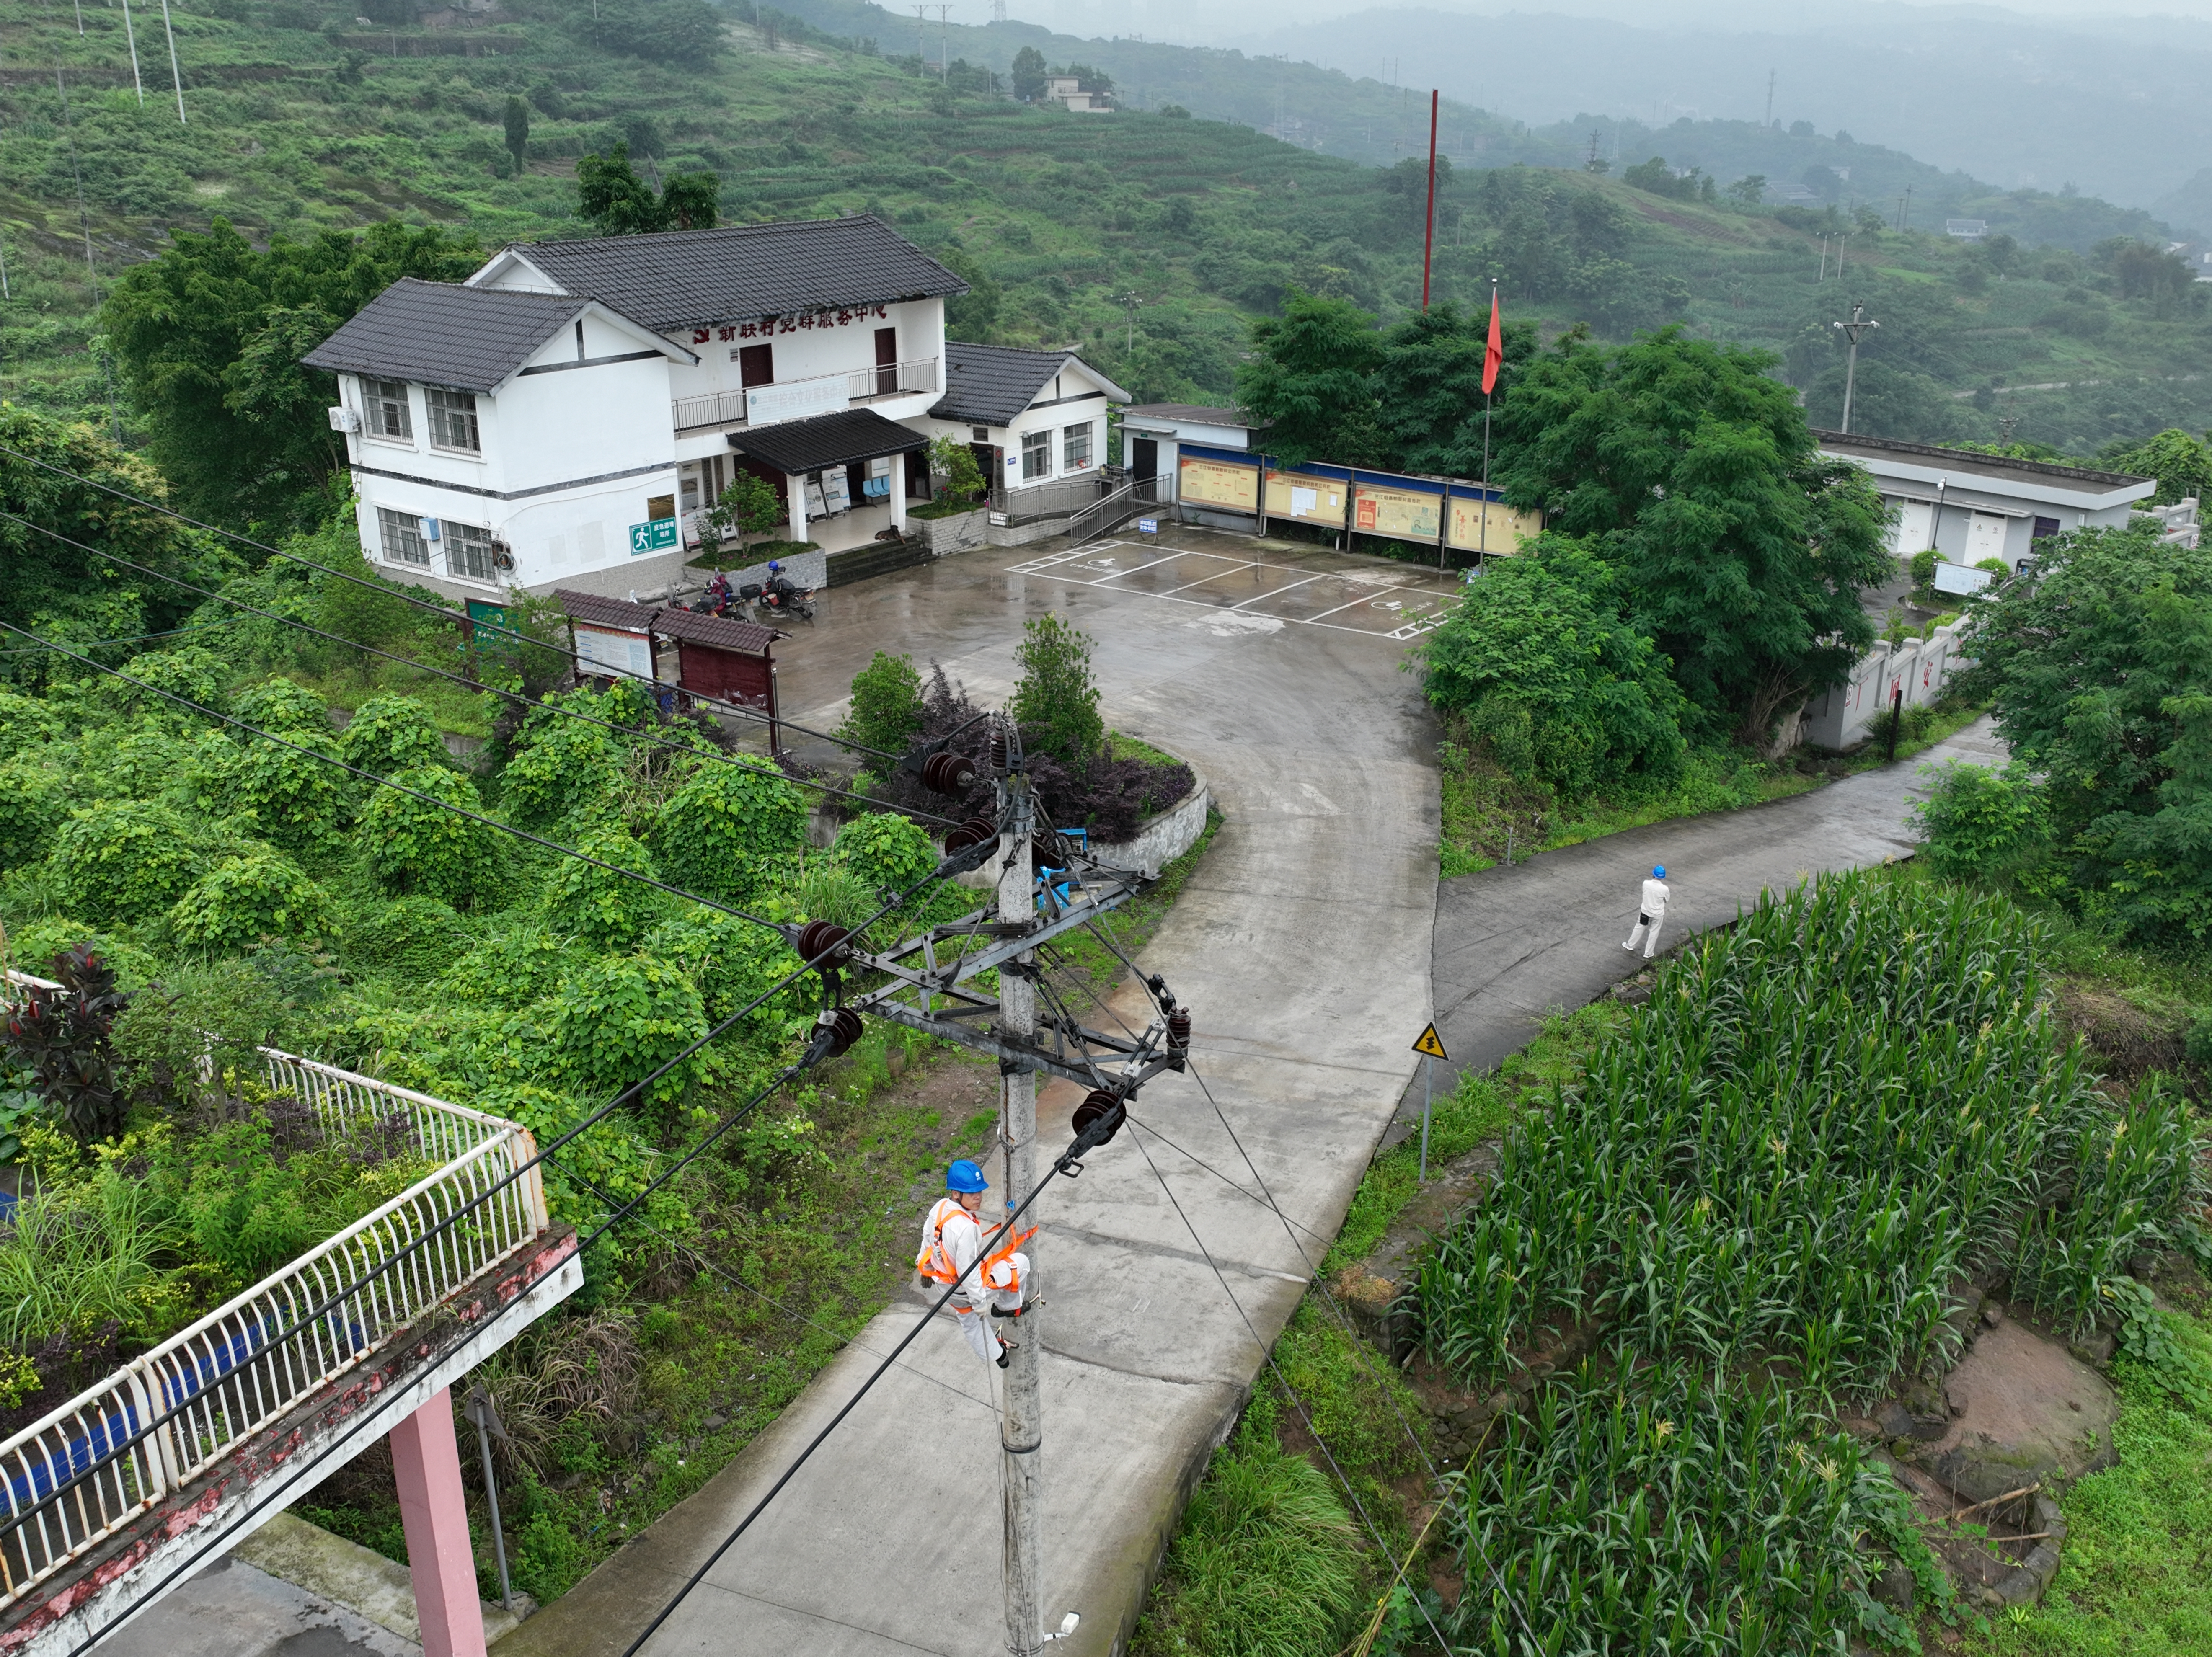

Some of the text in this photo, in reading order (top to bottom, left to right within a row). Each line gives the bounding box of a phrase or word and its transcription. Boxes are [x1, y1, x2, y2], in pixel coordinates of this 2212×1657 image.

[719, 305, 887, 342] 新联村党群服务中心
[654, 521, 674, 531] 应急避难
